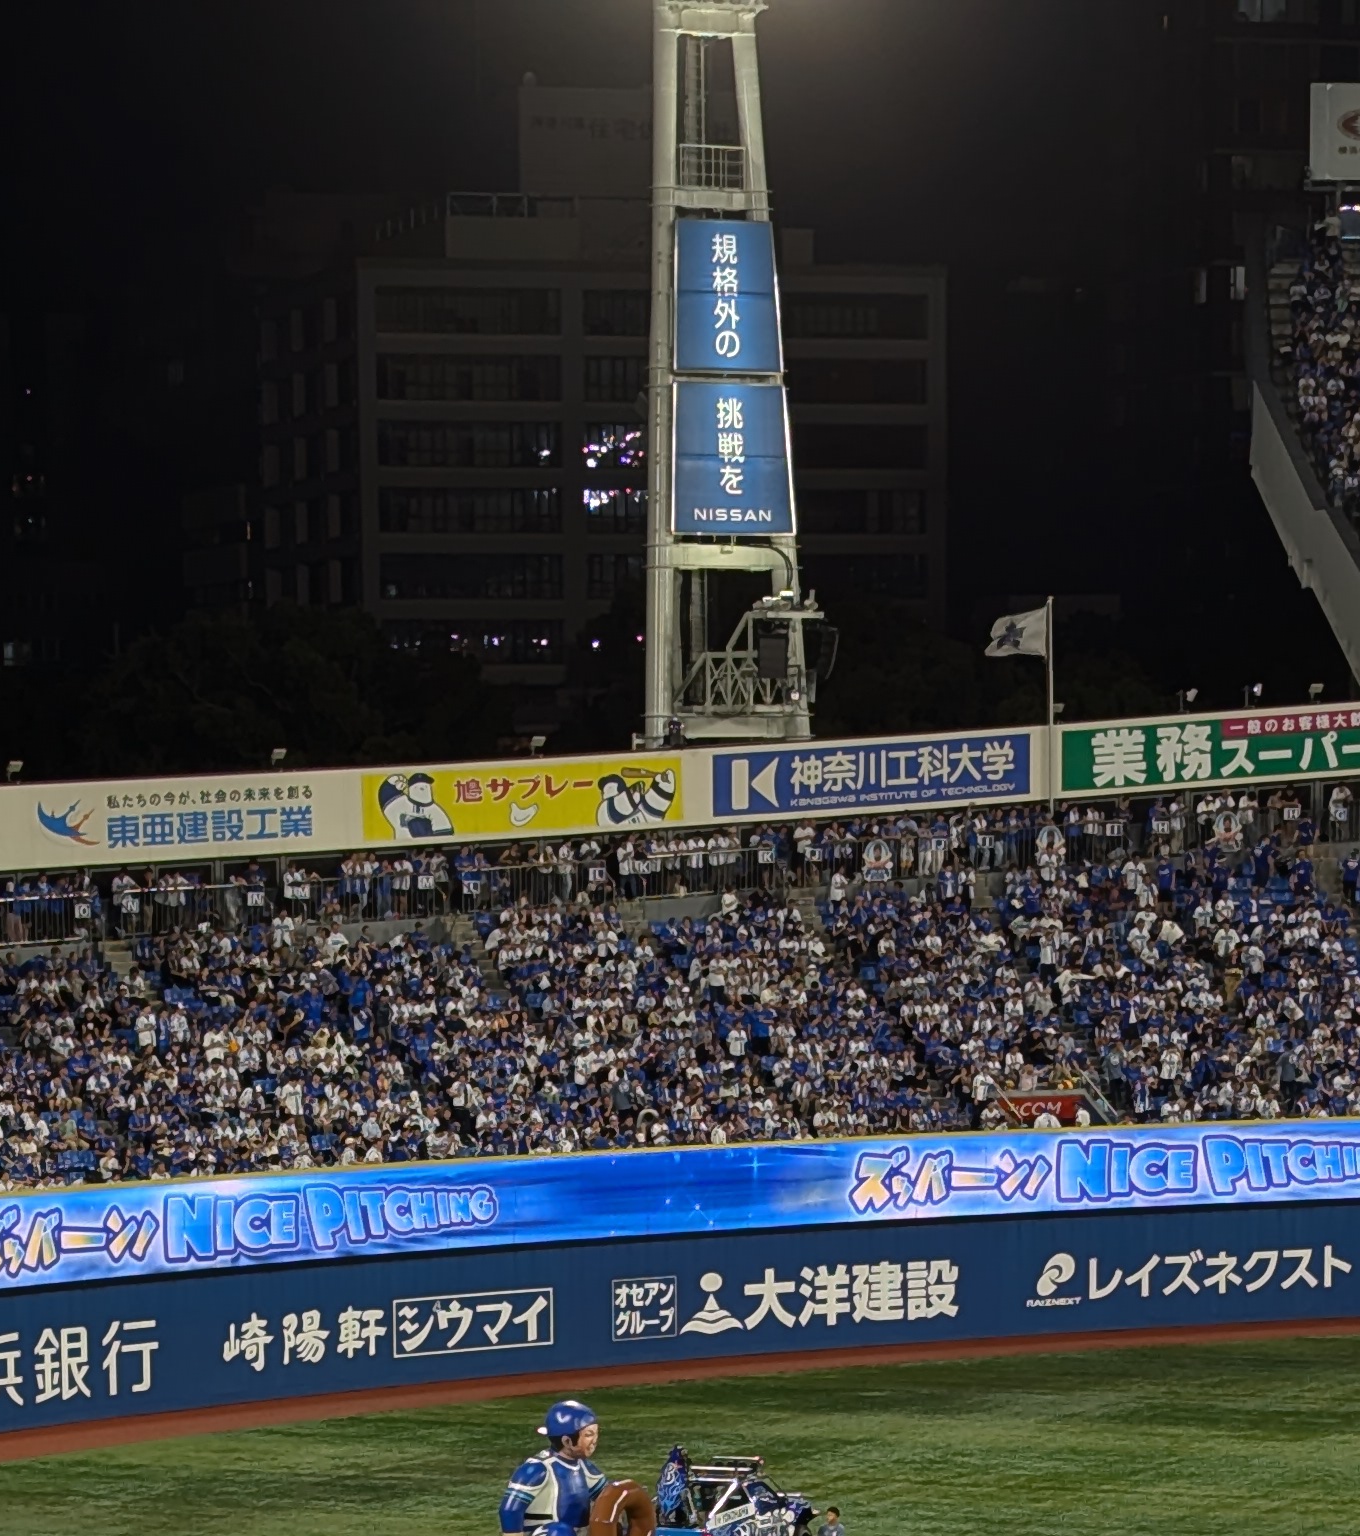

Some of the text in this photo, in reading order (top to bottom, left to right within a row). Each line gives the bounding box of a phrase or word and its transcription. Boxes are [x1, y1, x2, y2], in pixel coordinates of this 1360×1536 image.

[711, 233, 741, 358] 規格外の
[716, 397, 744, 495] 挑戦を
[693, 507, 772, 522] NISSAN
[453, 774, 594, 804] 鳩サブレー
[789, 739, 1016, 796] 神奈川工科大学
[106, 785, 313, 809] 私たちの今が、社会の未来を創る
[106, 805, 313, 849] 東亜建設工業
[1056, 1138, 1199, 1203] NICE
[162, 1181, 497, 1264] NICE PITCHING
[614, 1281, 675, 1309] オセアン
[743, 1259, 961, 1330] 大洋建設
[1087, 1244, 1353, 1301] レイズネクスト
[222, 1294, 550, 1373] 崎陽軒 シウマイ
[615, 1306, 675, 1337] グループ
